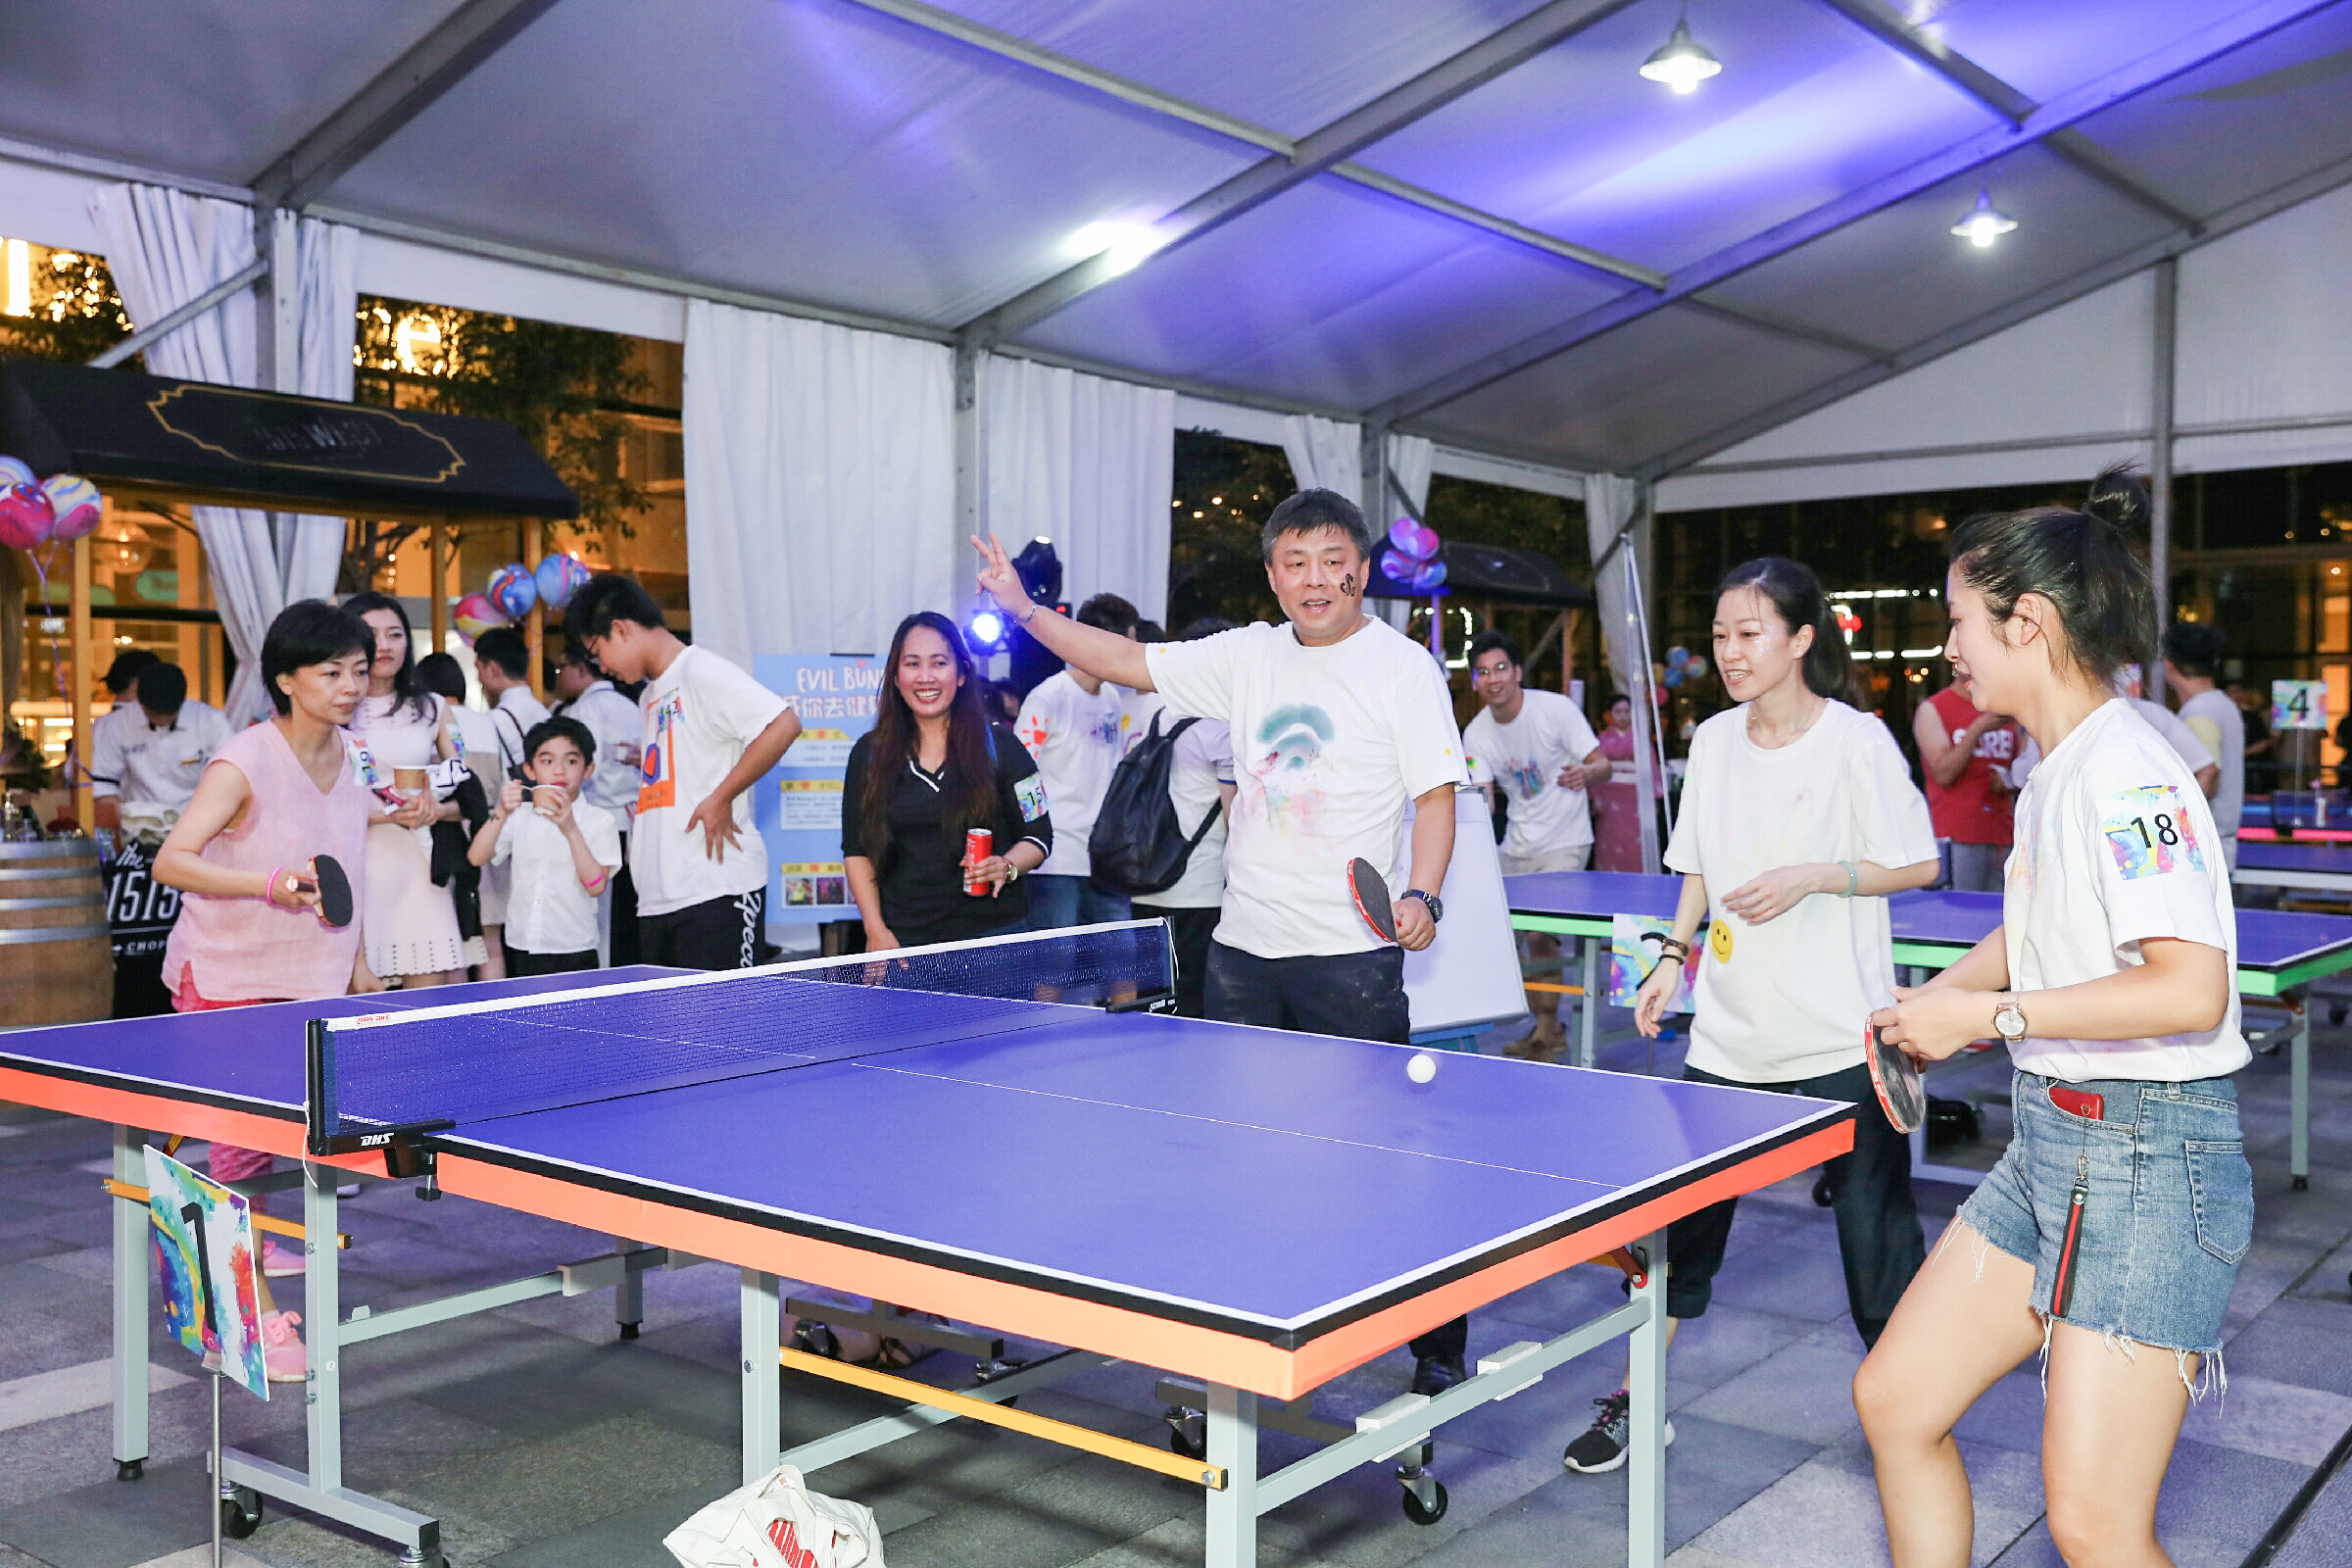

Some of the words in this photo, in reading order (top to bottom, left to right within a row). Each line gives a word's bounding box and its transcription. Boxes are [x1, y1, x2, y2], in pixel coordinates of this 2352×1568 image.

[797, 666, 840, 692] EVIL
[2286, 688, 2310, 720] 4
[1027, 786, 1043, 807] 15
[2131, 813, 2179, 849] 18
[116, 842, 145, 869] the
[107, 870, 179, 922] 1515
[360, 1132, 395, 1147] DHS
[179, 1201, 219, 1335] 1
